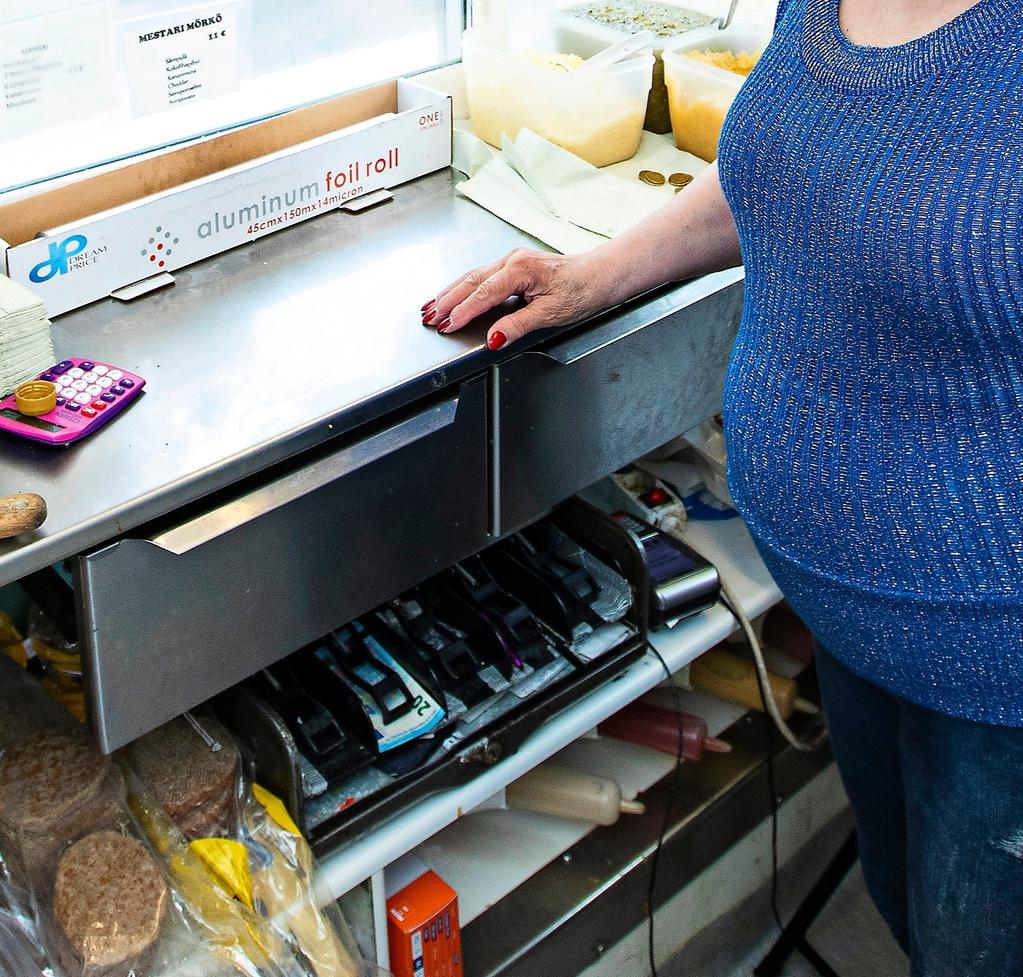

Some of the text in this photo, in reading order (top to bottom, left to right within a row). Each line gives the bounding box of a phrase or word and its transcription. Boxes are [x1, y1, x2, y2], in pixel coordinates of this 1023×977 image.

[139, 13, 222, 43] MESTARI MÖRKÖ
[208, 32, 218, 40] 11
[419, 111, 439, 125] ONE
[197, 147, 399, 239] aluminum foil roll
[246, 185, 364, 235] 45cmx150mx14micron
[68, 245, 108, 265] DREAM
[68, 257, 99, 272] PRICE
